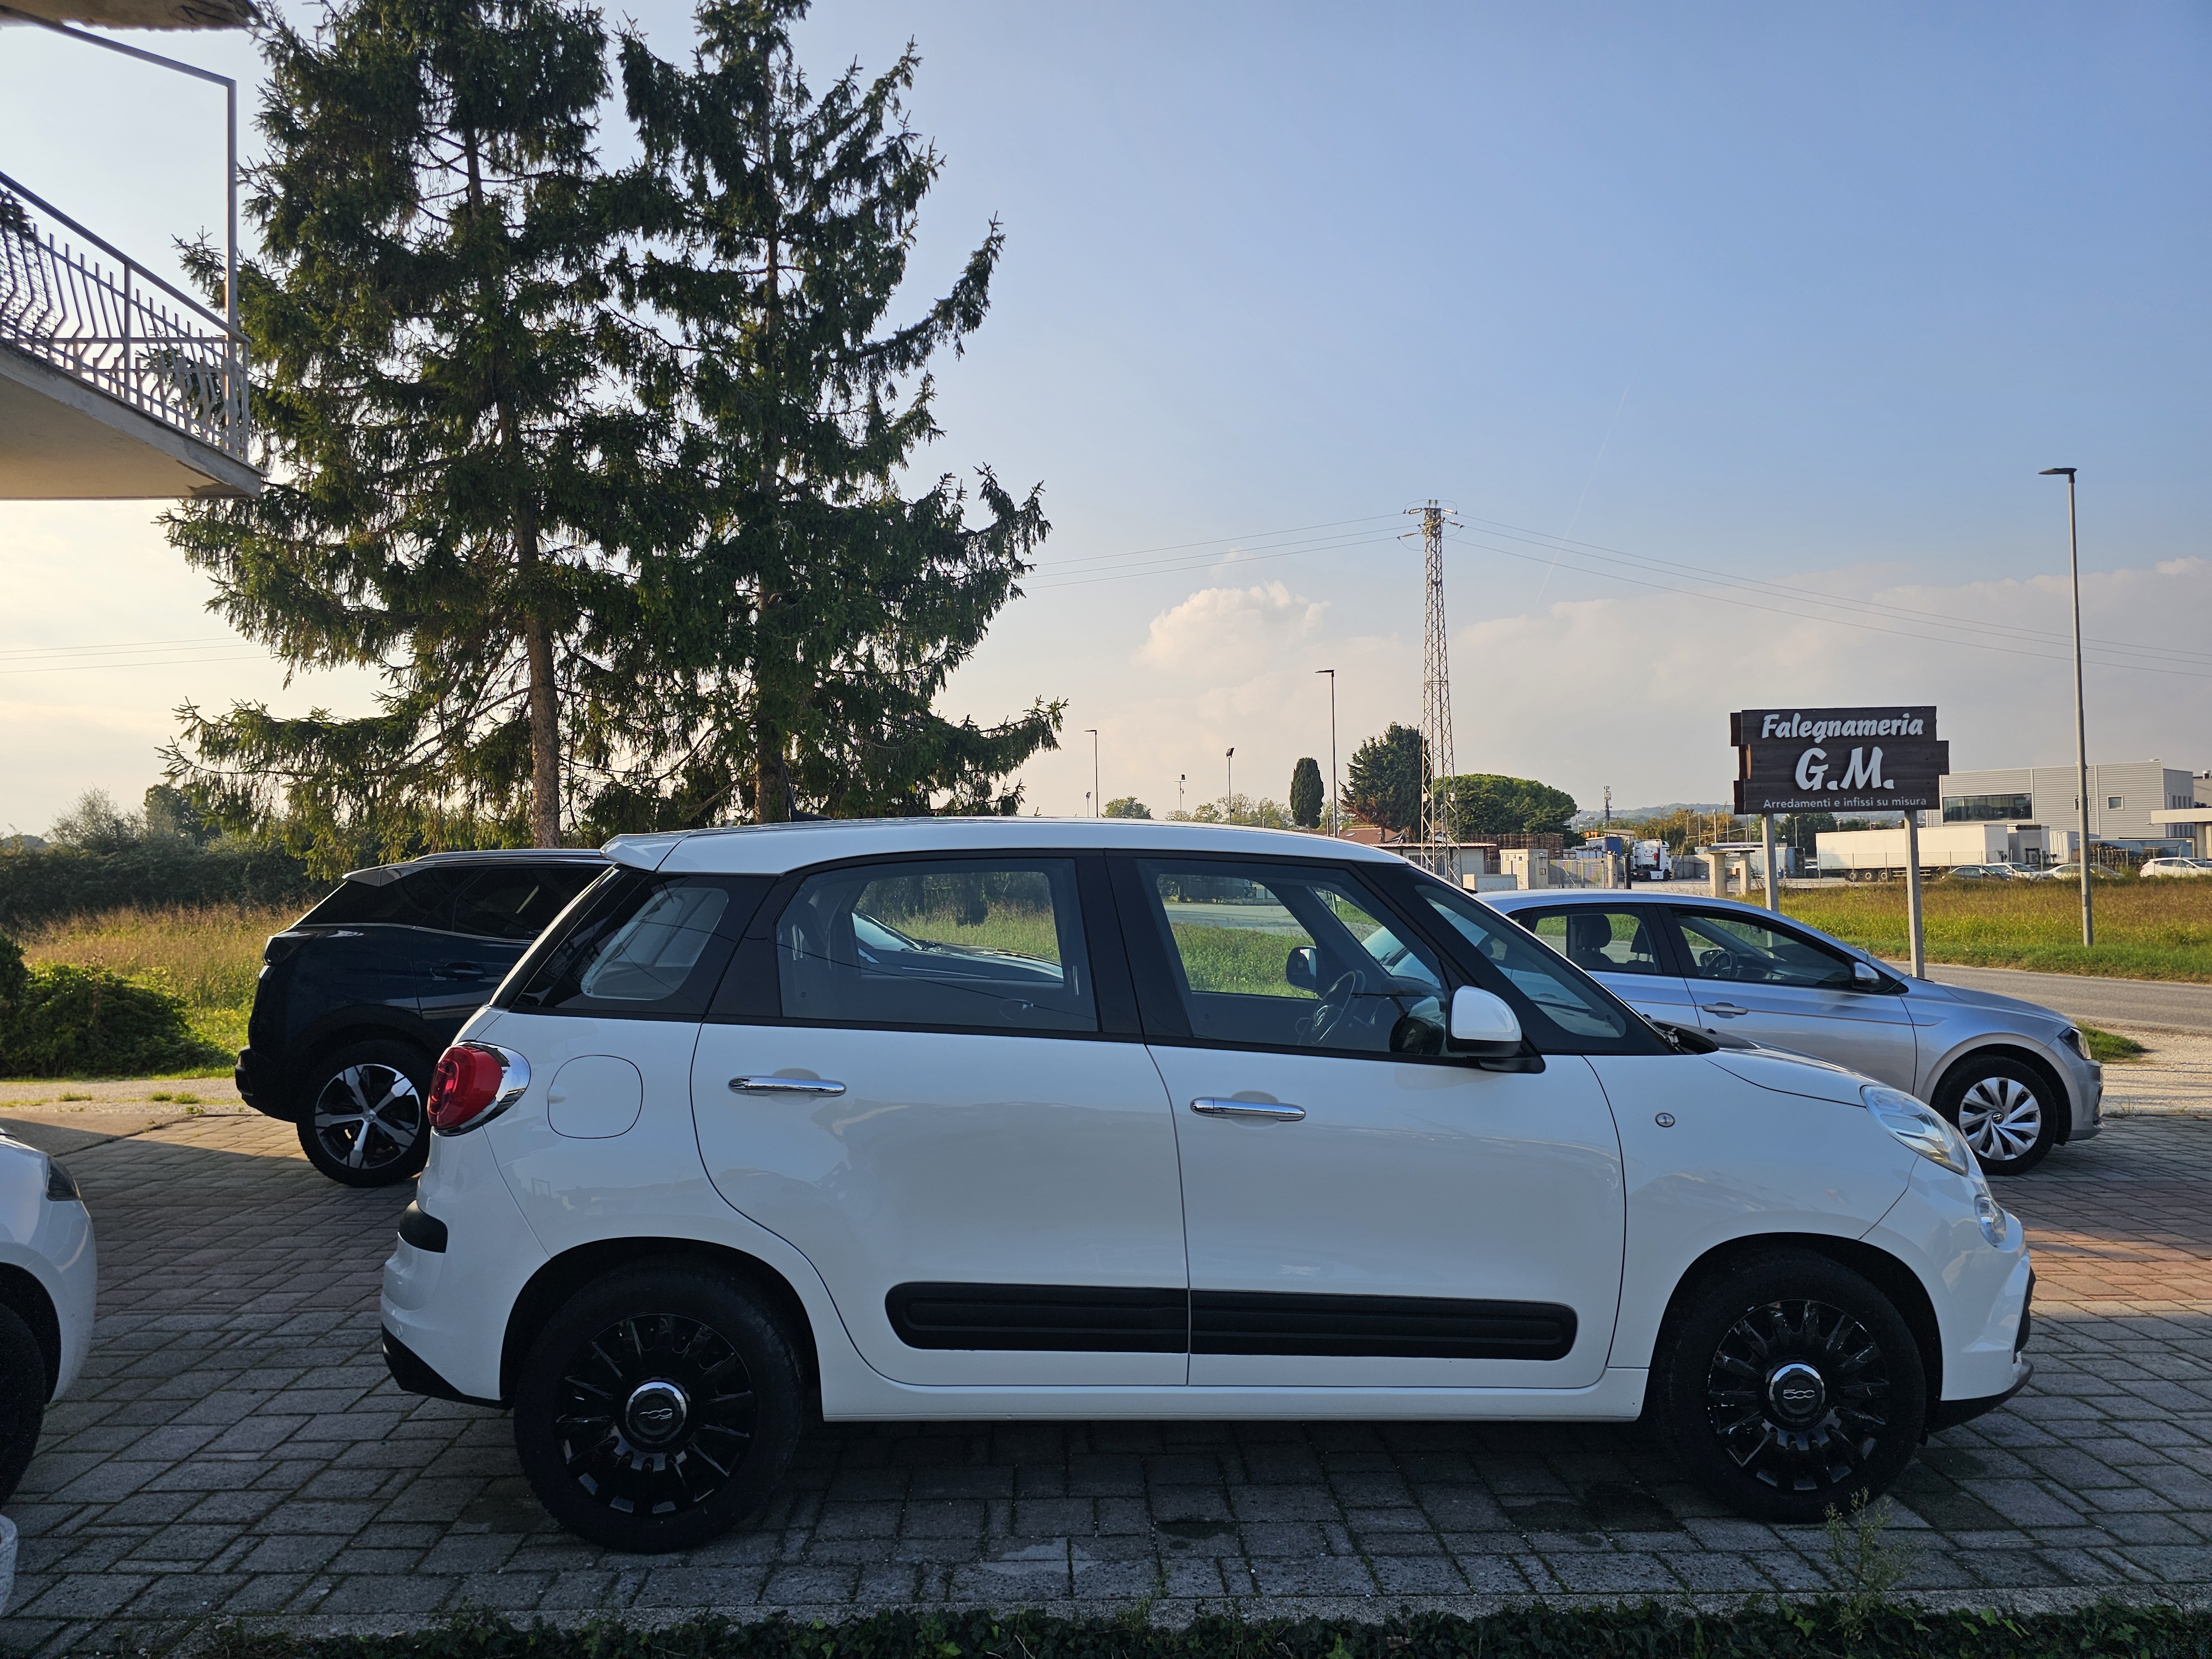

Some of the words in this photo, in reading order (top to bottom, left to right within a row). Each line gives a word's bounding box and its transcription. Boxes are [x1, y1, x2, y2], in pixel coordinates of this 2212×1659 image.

[1761, 712, 1924, 744] Falegnameria
[1794, 746, 1895, 791] G.M.
[1763, 798, 1830, 808] Arredamenti
[1843, 797, 1874, 807] infissi
[1891, 796, 1927, 806] misura
[1782, 1389, 1815, 1400] 500
